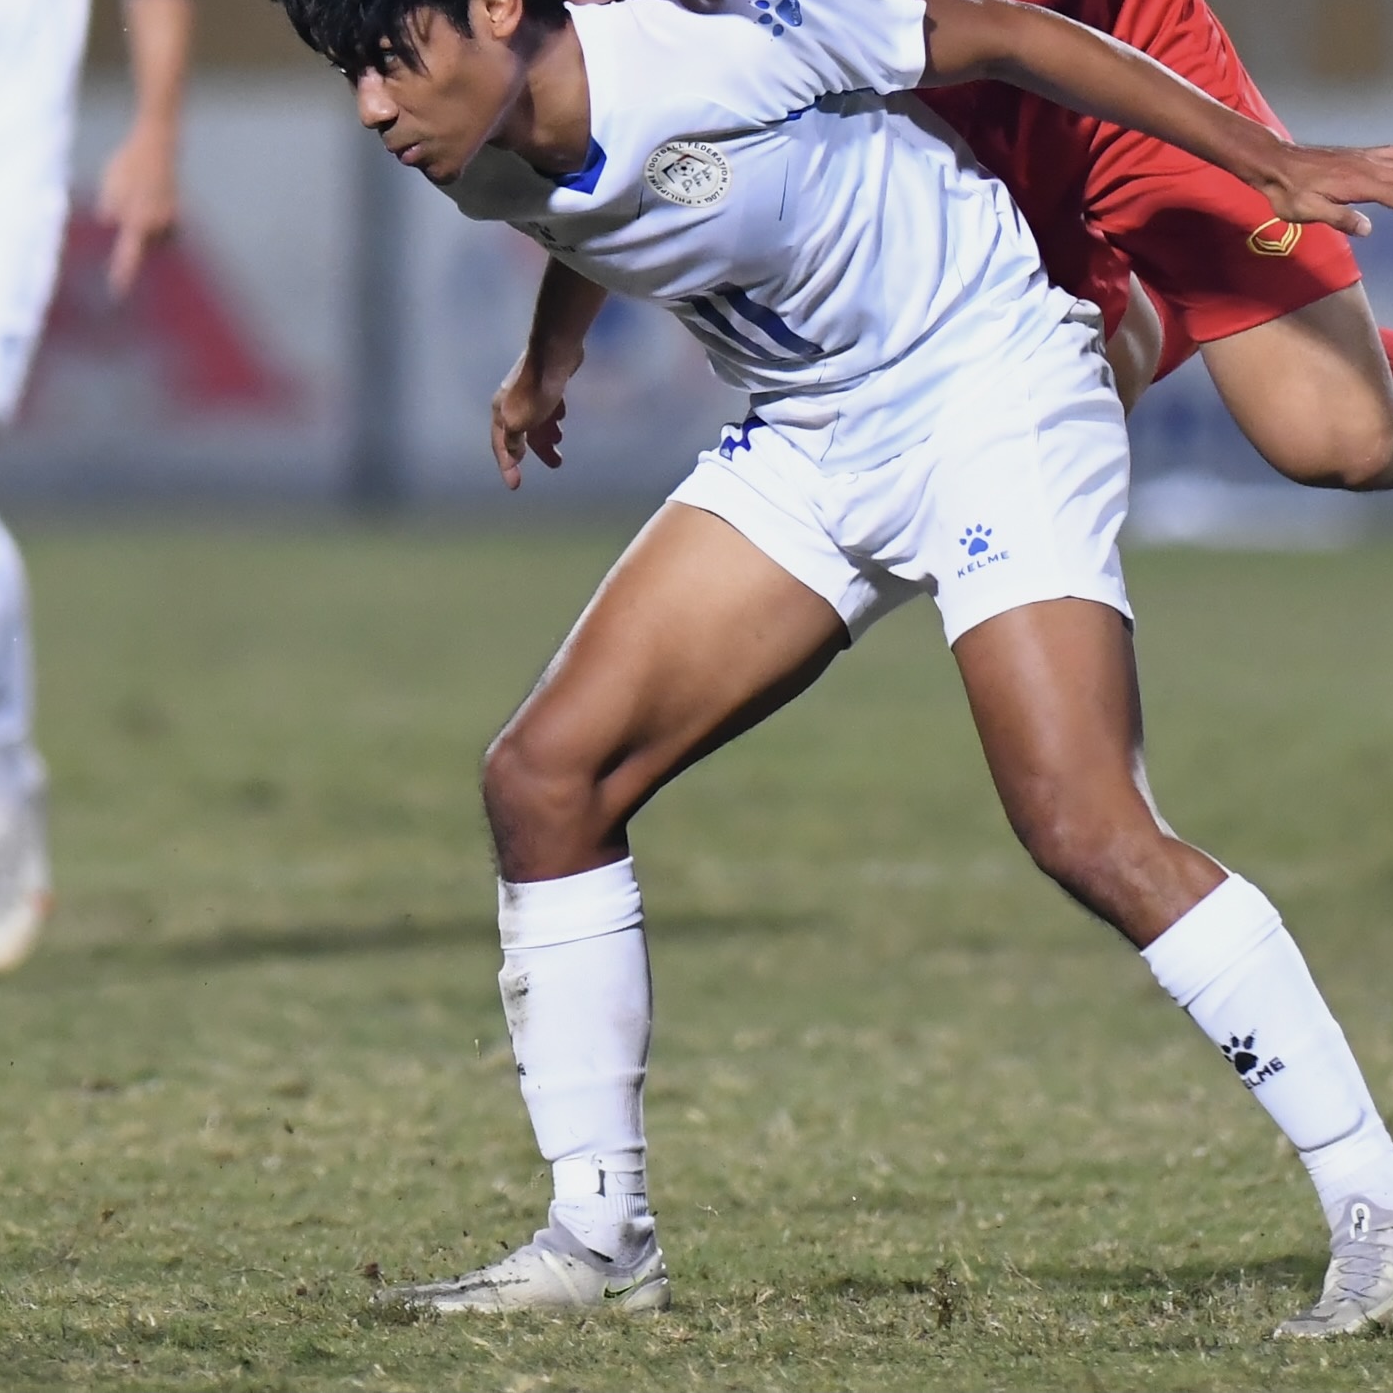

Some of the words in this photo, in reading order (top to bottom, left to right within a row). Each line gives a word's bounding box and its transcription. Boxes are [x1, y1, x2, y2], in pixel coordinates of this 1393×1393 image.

[647, 142, 685, 173] FOOTBALL
[687, 142, 729, 184] FEDERATION
[647, 174, 693, 205] PHILIPPINE
[703, 190, 721, 203] 1907
[957, 550, 1010, 579] KELME
[1241, 1056, 1286, 1090] ELME
